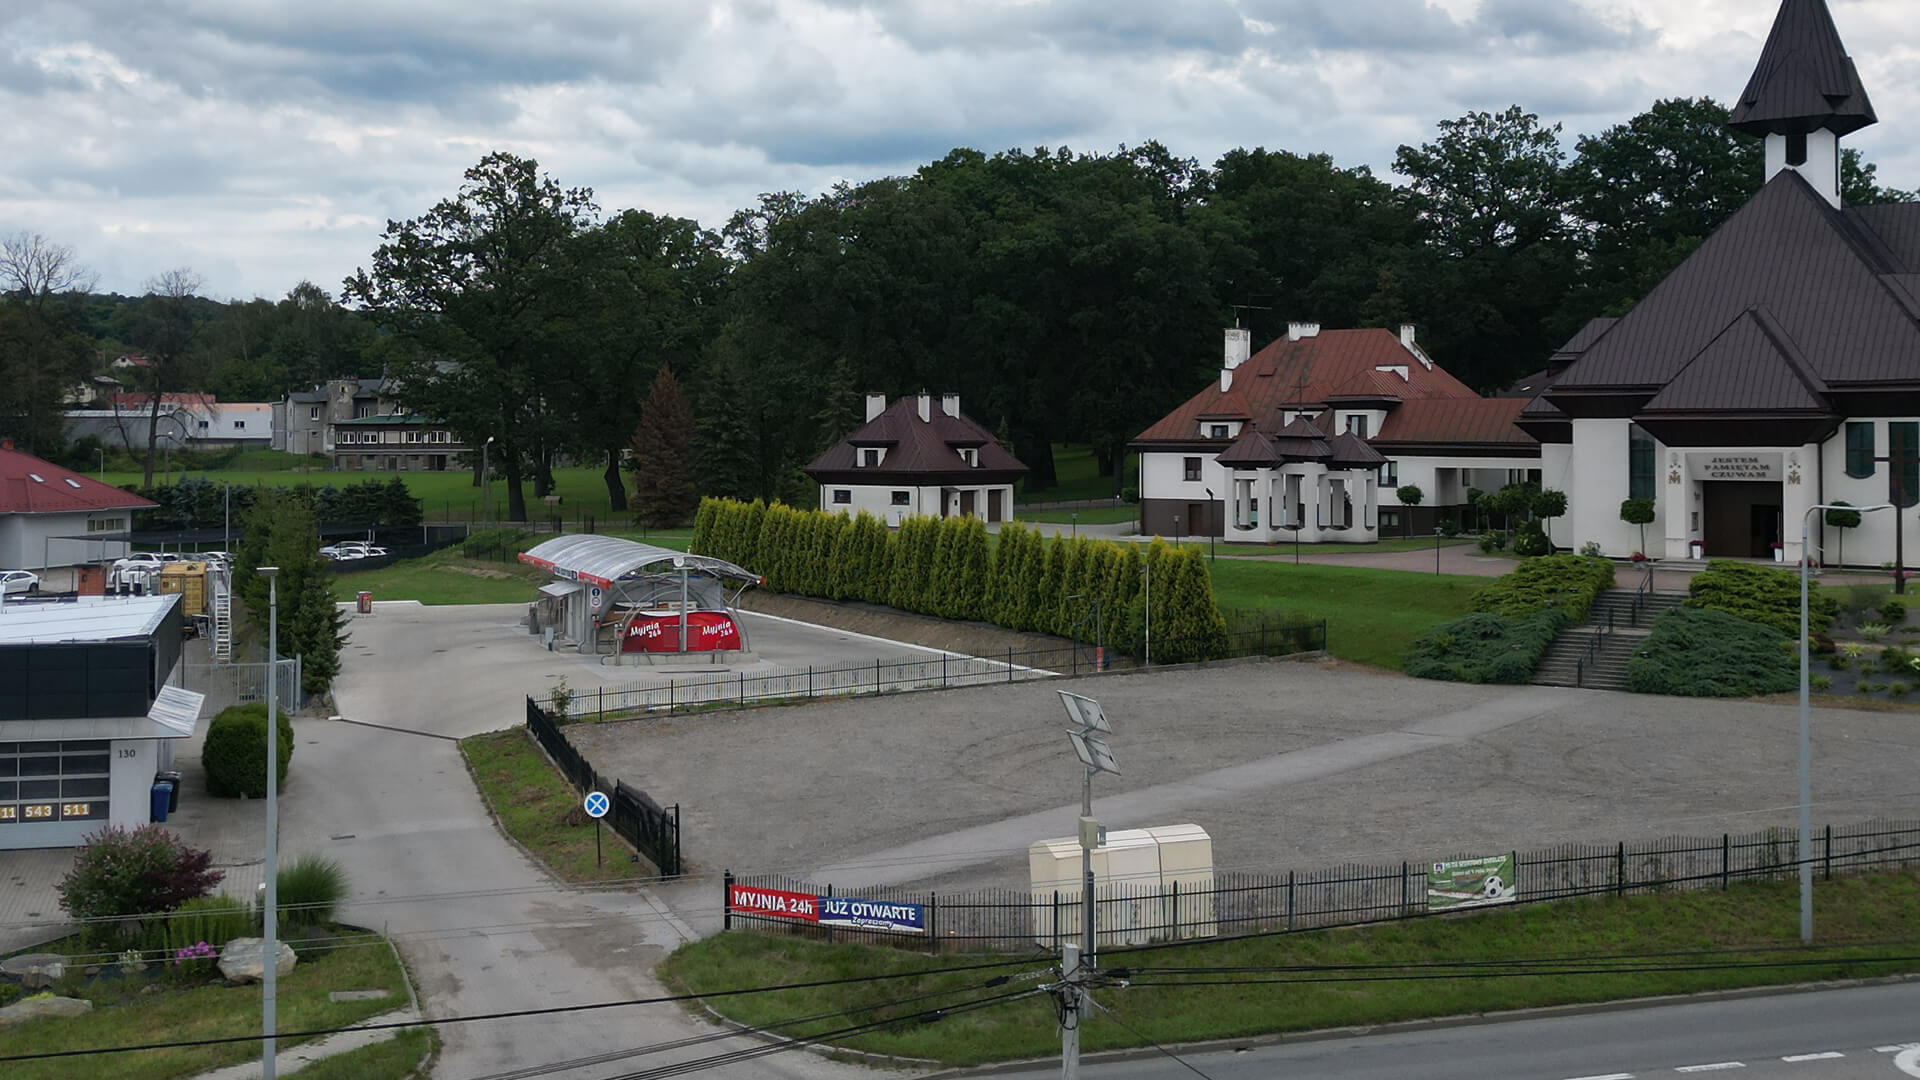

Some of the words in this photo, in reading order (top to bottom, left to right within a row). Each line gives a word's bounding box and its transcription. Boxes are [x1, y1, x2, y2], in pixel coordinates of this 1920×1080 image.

[630, 622, 660, 636] Myjnia
[702, 620, 731, 636] Myjnia
[118, 749, 136, 758] 130
[25, 805, 52, 817] 543
[63, 804, 89, 815] 511
[734, 890, 787, 911] MYJNIA
[790, 898, 813, 915] 24h
[824, 898, 849, 916] JUŻ
[851, 902, 916, 921] OTWARTE
